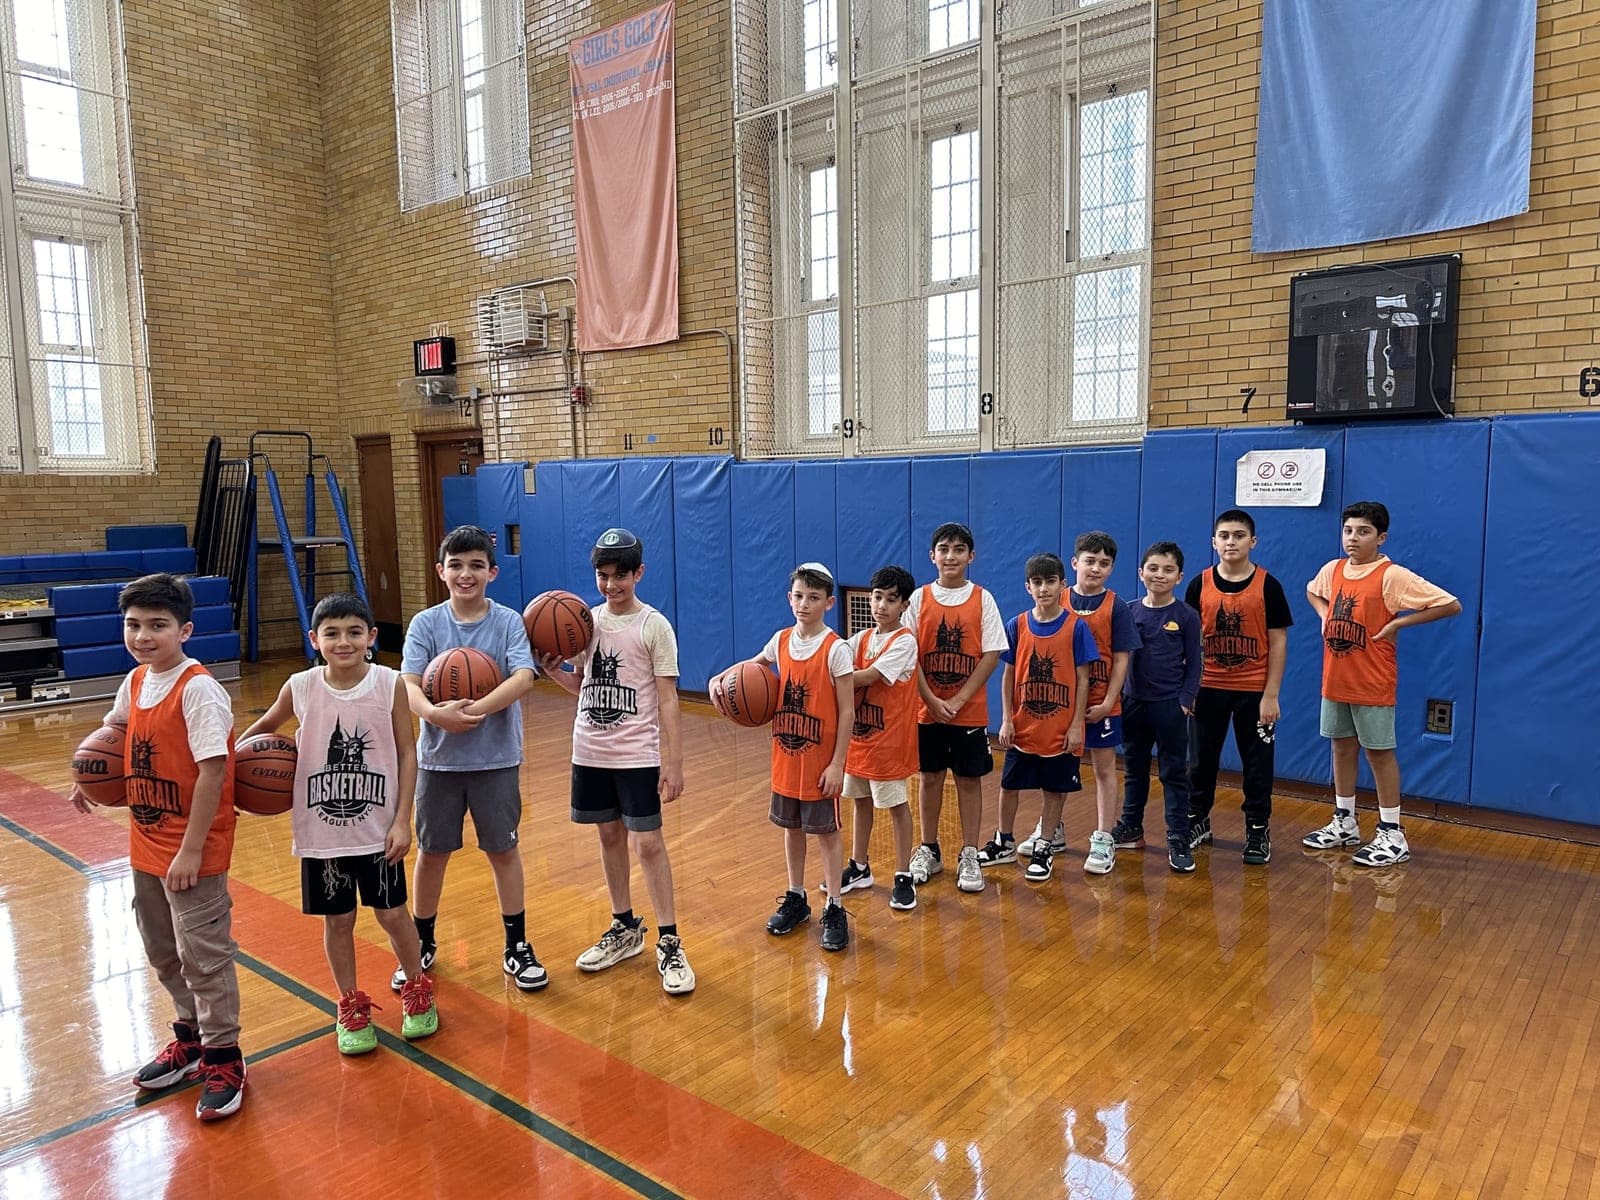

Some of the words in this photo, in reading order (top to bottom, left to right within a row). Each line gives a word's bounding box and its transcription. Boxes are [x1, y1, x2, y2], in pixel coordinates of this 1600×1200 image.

[583, 28, 620, 65] GIRLS
[624, 11, 659, 48] GOLF
[1580, 367, 1600, 397] 6
[460, 399, 472, 417] 12
[981, 393, 992, 415] 8
[1240, 387, 1256, 414] 7
[709, 427, 723, 445] 10
[843, 419, 853, 438] 9
[624, 433, 632, 450] 11
[614, 714, 628, 728] NYC
[325, 763, 367, 773] BETTER
[309, 773, 384, 806] BASKETBALL
[316, 807, 349, 827] LEAGUE
[357, 805, 374, 822] NYC
